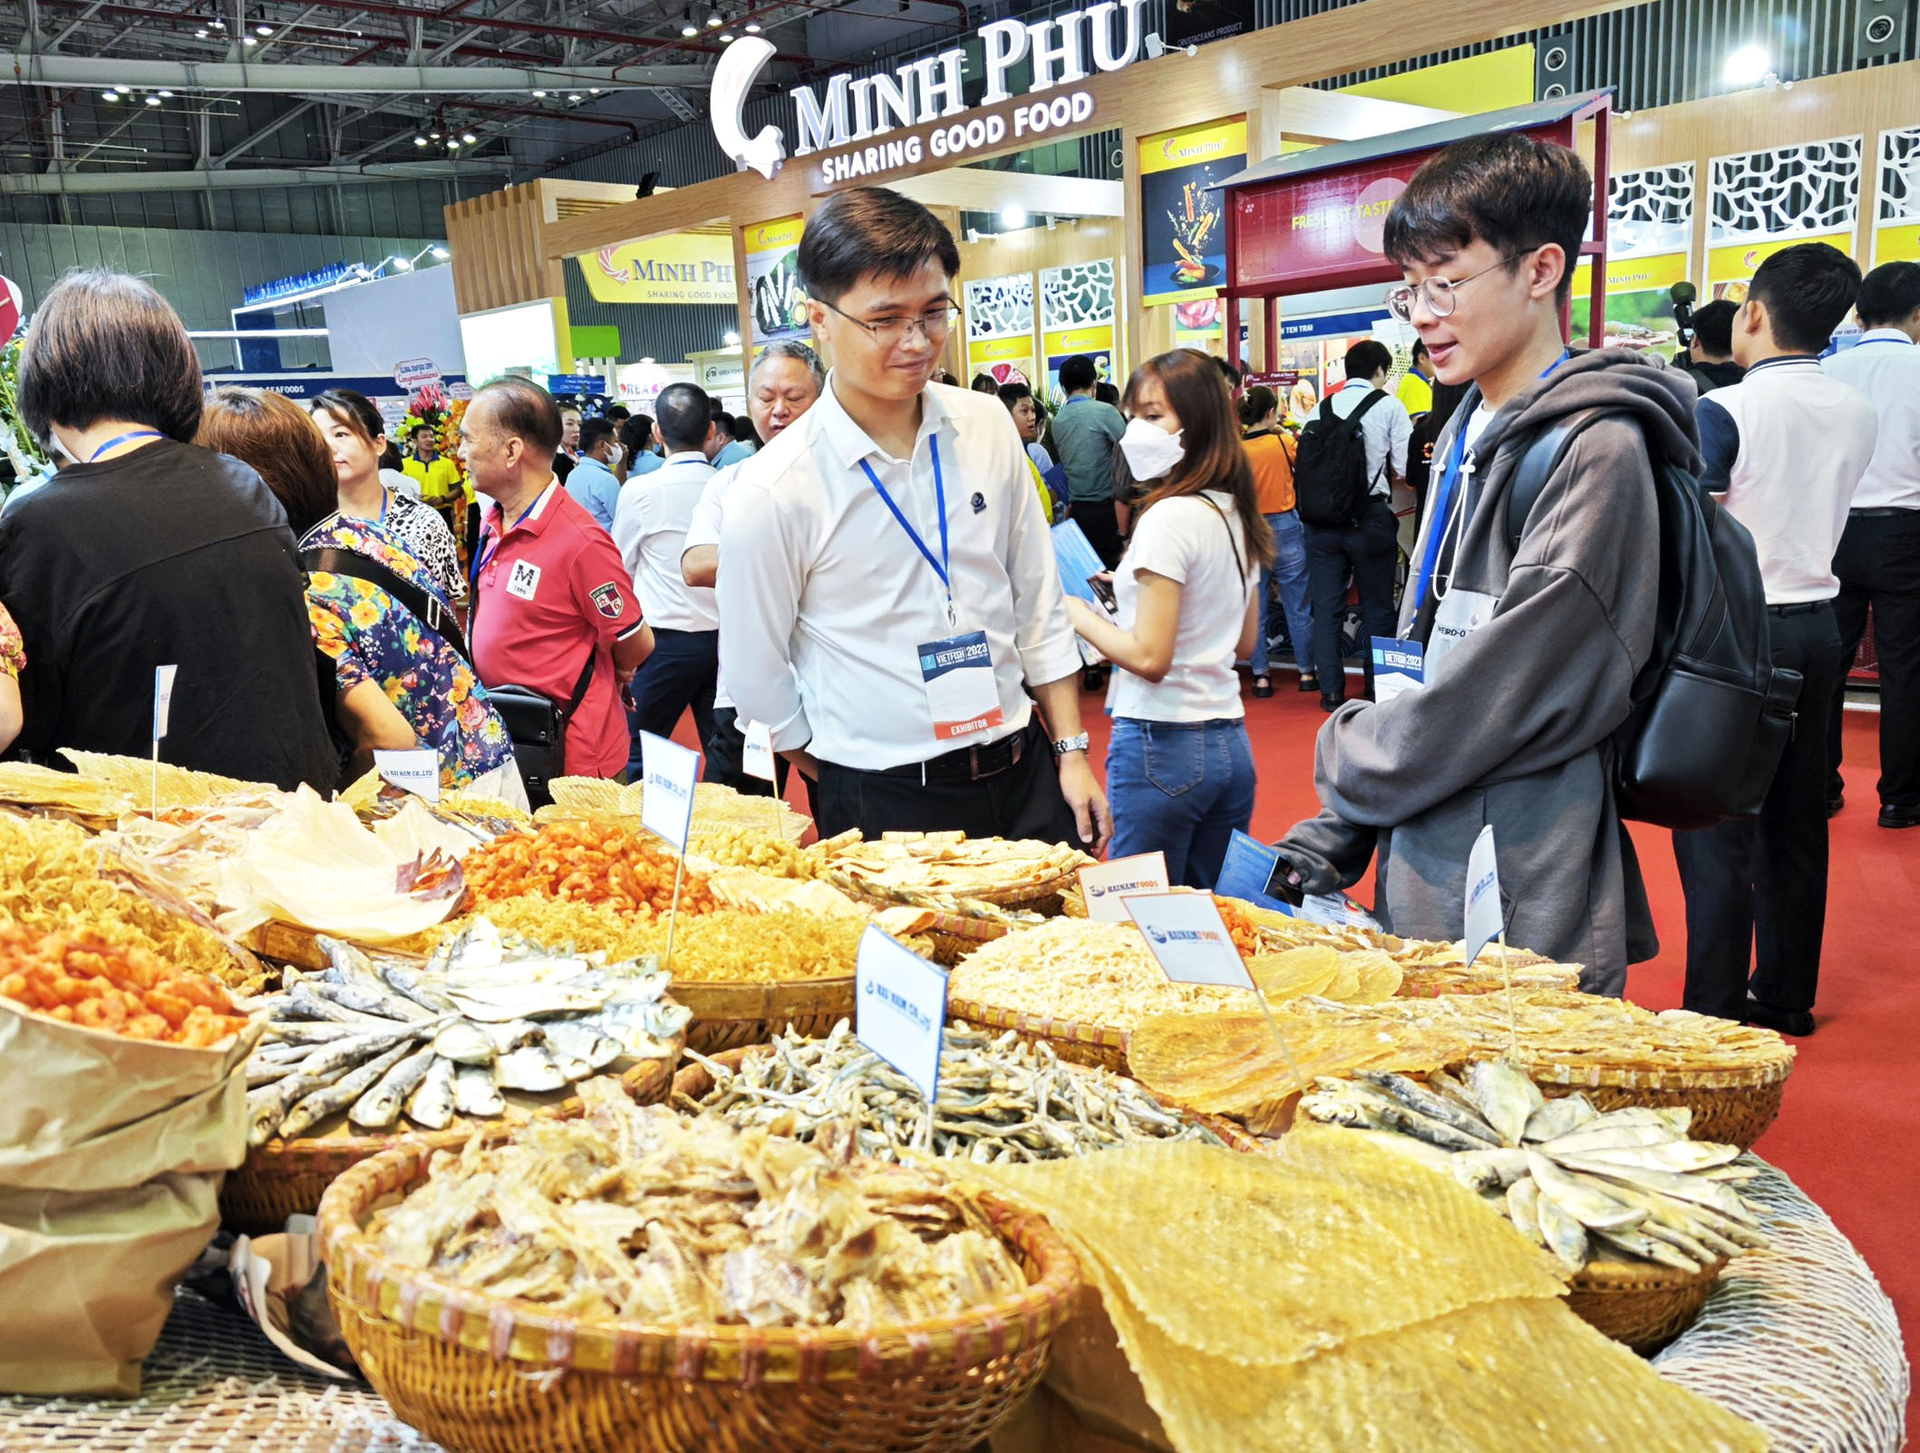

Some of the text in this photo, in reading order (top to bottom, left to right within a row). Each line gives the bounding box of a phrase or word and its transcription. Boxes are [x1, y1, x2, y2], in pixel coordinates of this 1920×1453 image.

[1216, 21, 1243, 36] PRODUCT
[790, 0, 1147, 157] MINH PHU
[821, 91, 1095, 184] SHARING GOOD FOOD
[632, 258, 697, 283] MINH
[647, 290, 685, 299] SHARING
[688, 291, 712, 299] GOOD
[1286, 323, 1314, 335] TEN TRAI
[514, 563, 535, 587] M
[936, 650, 965, 664] VIETFISH
[966, 643, 988, 657] 2023
[1406, 654, 1422, 667] 2023
[950, 718, 988, 736] EXHIBITOR
